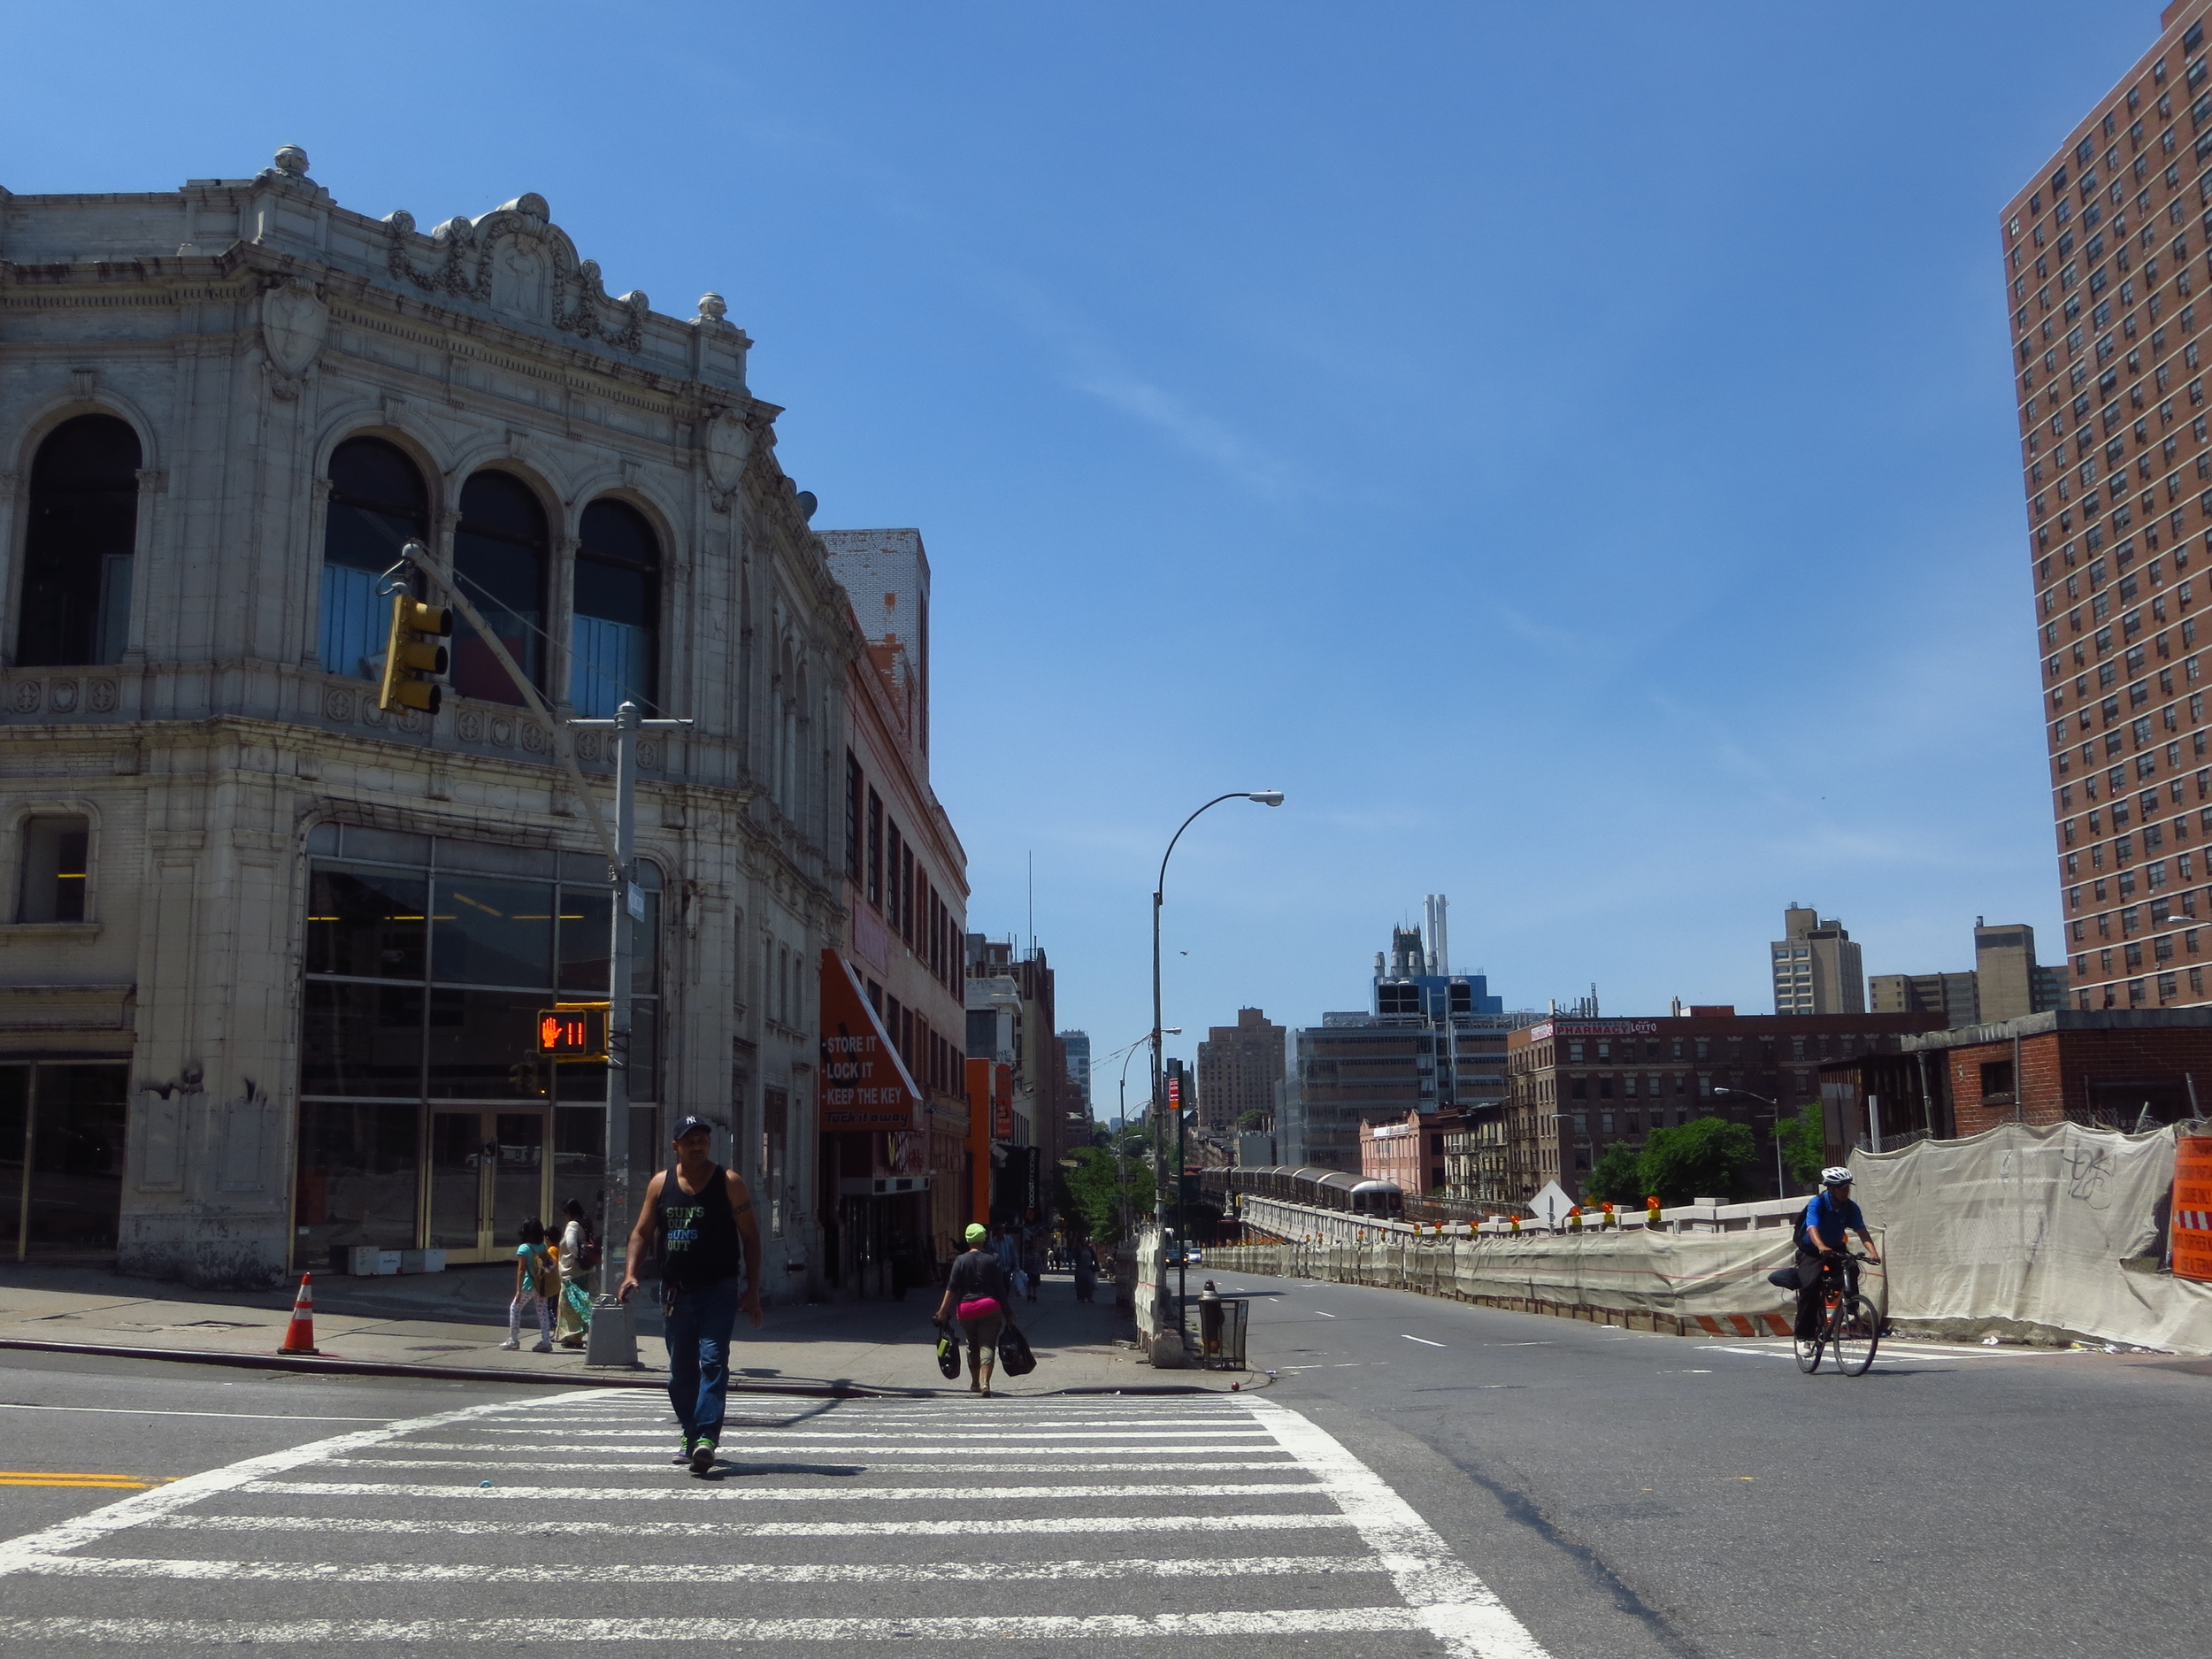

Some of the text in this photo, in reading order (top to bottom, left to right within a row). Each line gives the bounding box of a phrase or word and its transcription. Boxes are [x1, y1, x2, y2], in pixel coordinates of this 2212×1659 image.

[567, 1022, 584, 1046] 11
[1631, 1023, 1657, 1032] LOTTO
[827, 1035, 877, 1053] STORE IT
[826, 1062, 874, 1079] LOCK IT
[827, 1087, 902, 1105] KEEP THE KEY
[824, 1111, 909, 1127] Tuck it away
[666, 1207, 704, 1218] SUN'S
[667, 1218, 691, 1229] OUT
[667, 1229, 698, 1240] GUNS
[667, 1240, 691, 1251] OUT
